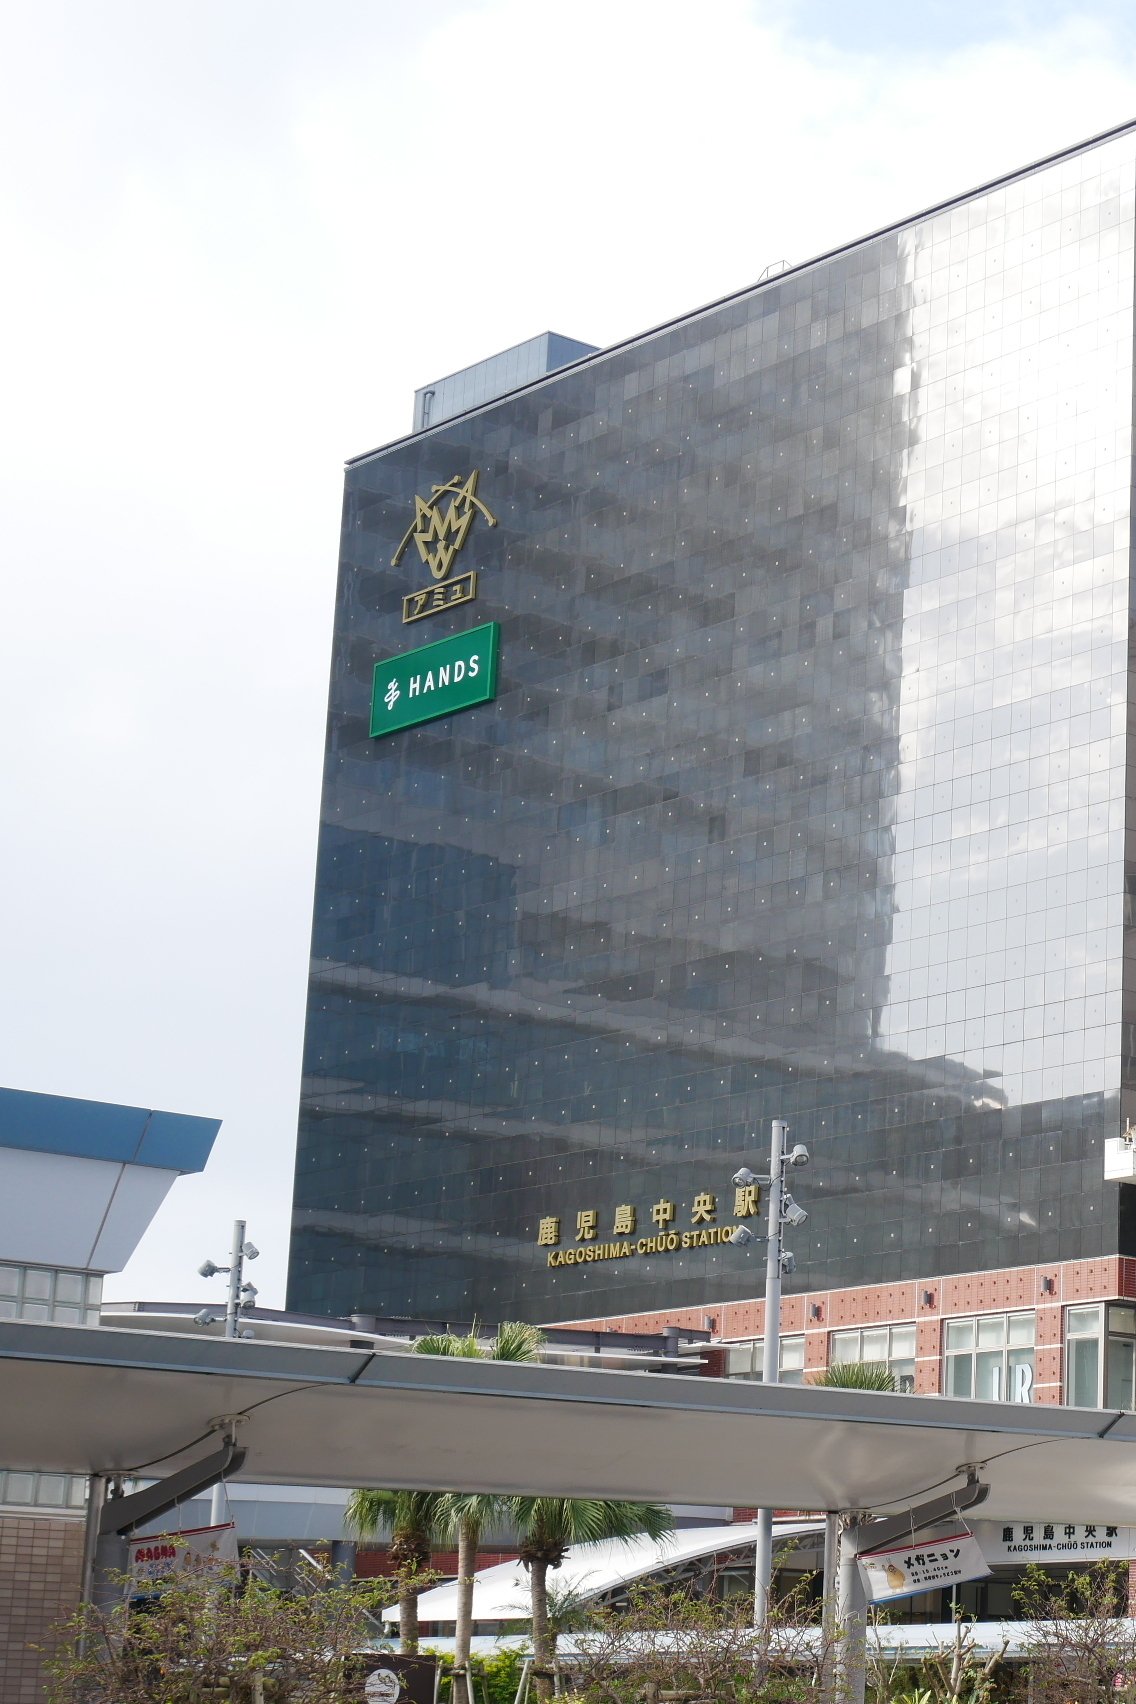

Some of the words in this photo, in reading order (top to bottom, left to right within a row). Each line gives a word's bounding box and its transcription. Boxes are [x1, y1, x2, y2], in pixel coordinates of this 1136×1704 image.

[408, 654, 480, 698] HANDS
[537, 1184, 760, 1247] 鹿児島中央駅
[903, 1548, 961, 1570] メガニョン
[1080, 1541, 1112, 1549] STATION
